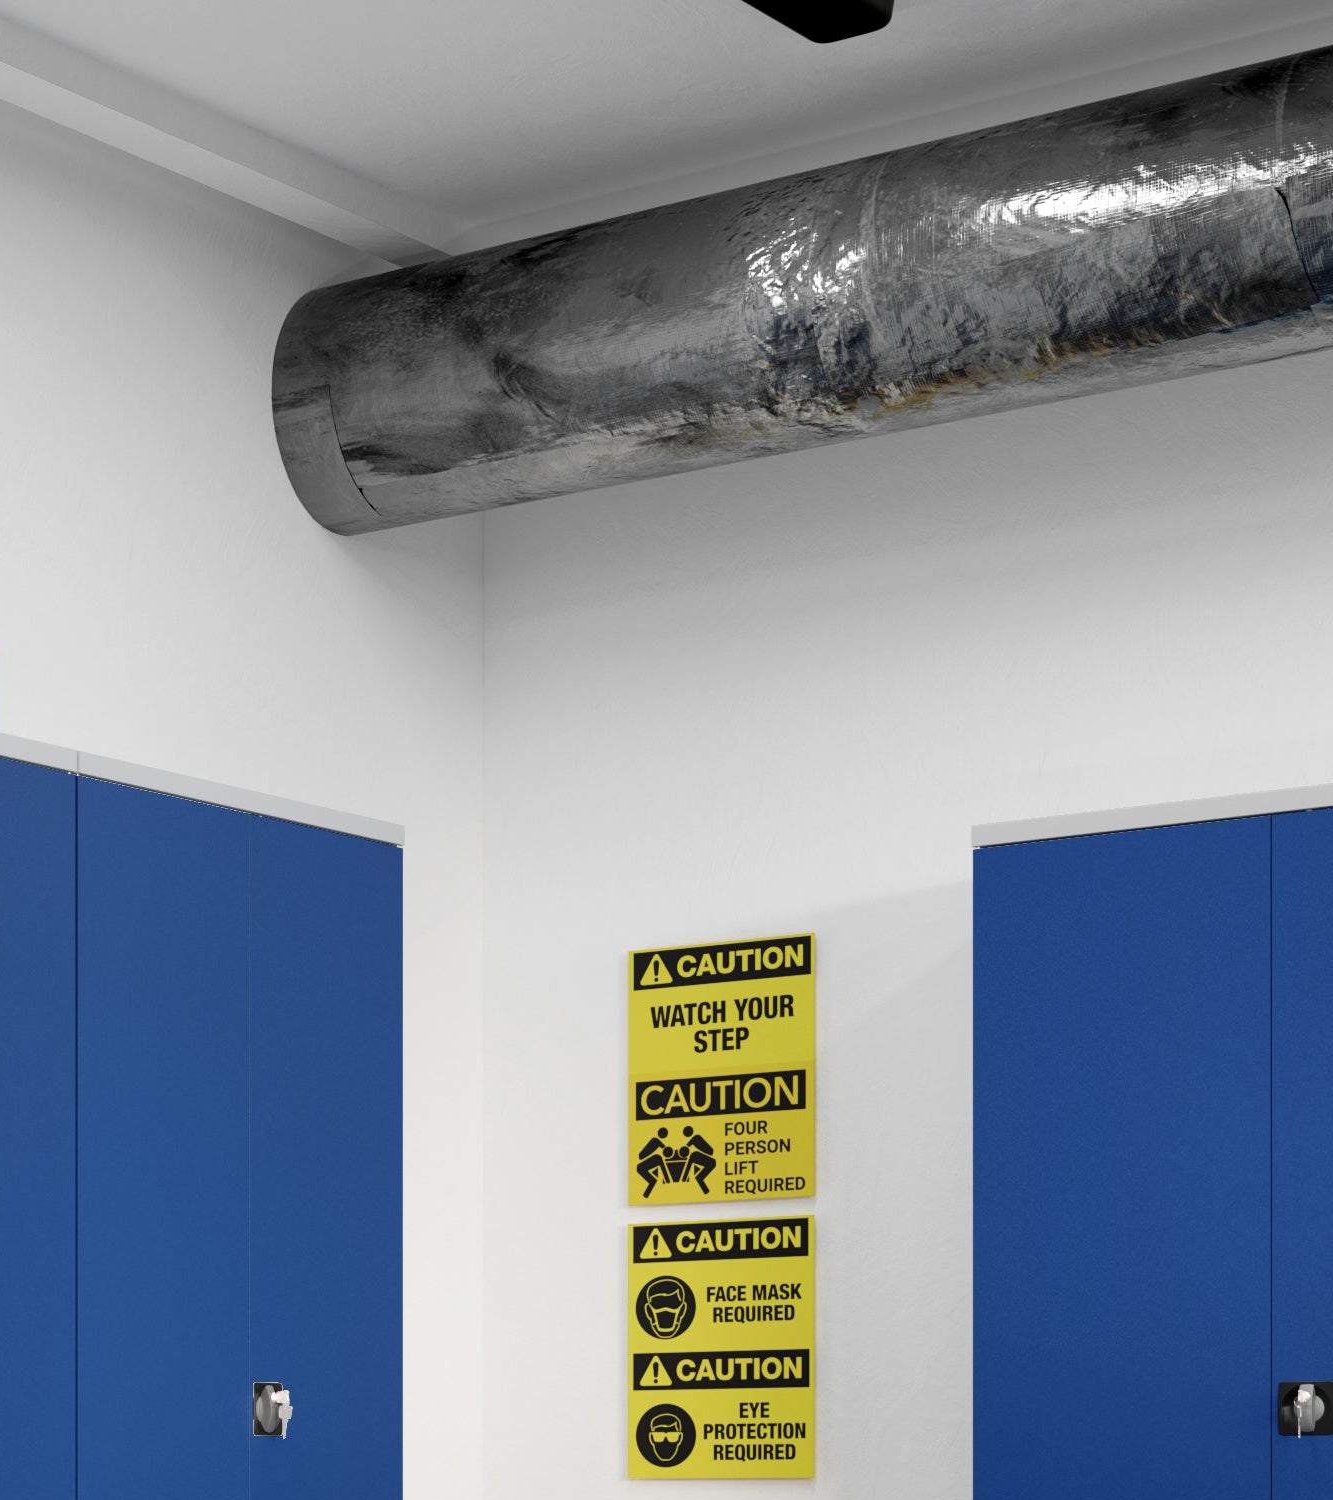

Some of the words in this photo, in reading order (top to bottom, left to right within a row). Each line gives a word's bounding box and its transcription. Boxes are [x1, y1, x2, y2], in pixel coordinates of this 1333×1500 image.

[676, 943, 805, 979] CAUTION
[650, 1000, 727, 1029] WATCH
[734, 994, 795, 1022] YOUR
[693, 1027, 750, 1053] STEP
[640, 1074, 800, 1116] CAUTION
[724, 1120, 768, 1136] FOUR
[724, 1138, 792, 1156] PERSON
[724, 1160, 759, 1176] LIFT
[724, 1176, 806, 1195] REQUIRED
[675, 1225, 802, 1254] CAUTION
[706, 1285, 747, 1302] FACE
[752, 1283, 802, 1300] MASK
[712, 1304, 795, 1324] REQUIRED
[675, 1356, 803, 1382] CAUTION
[739, 1402, 770, 1419] EYE
[703, 1422, 806, 1440] PROTECTION
[713, 1444, 796, 1462] REQUIRED
